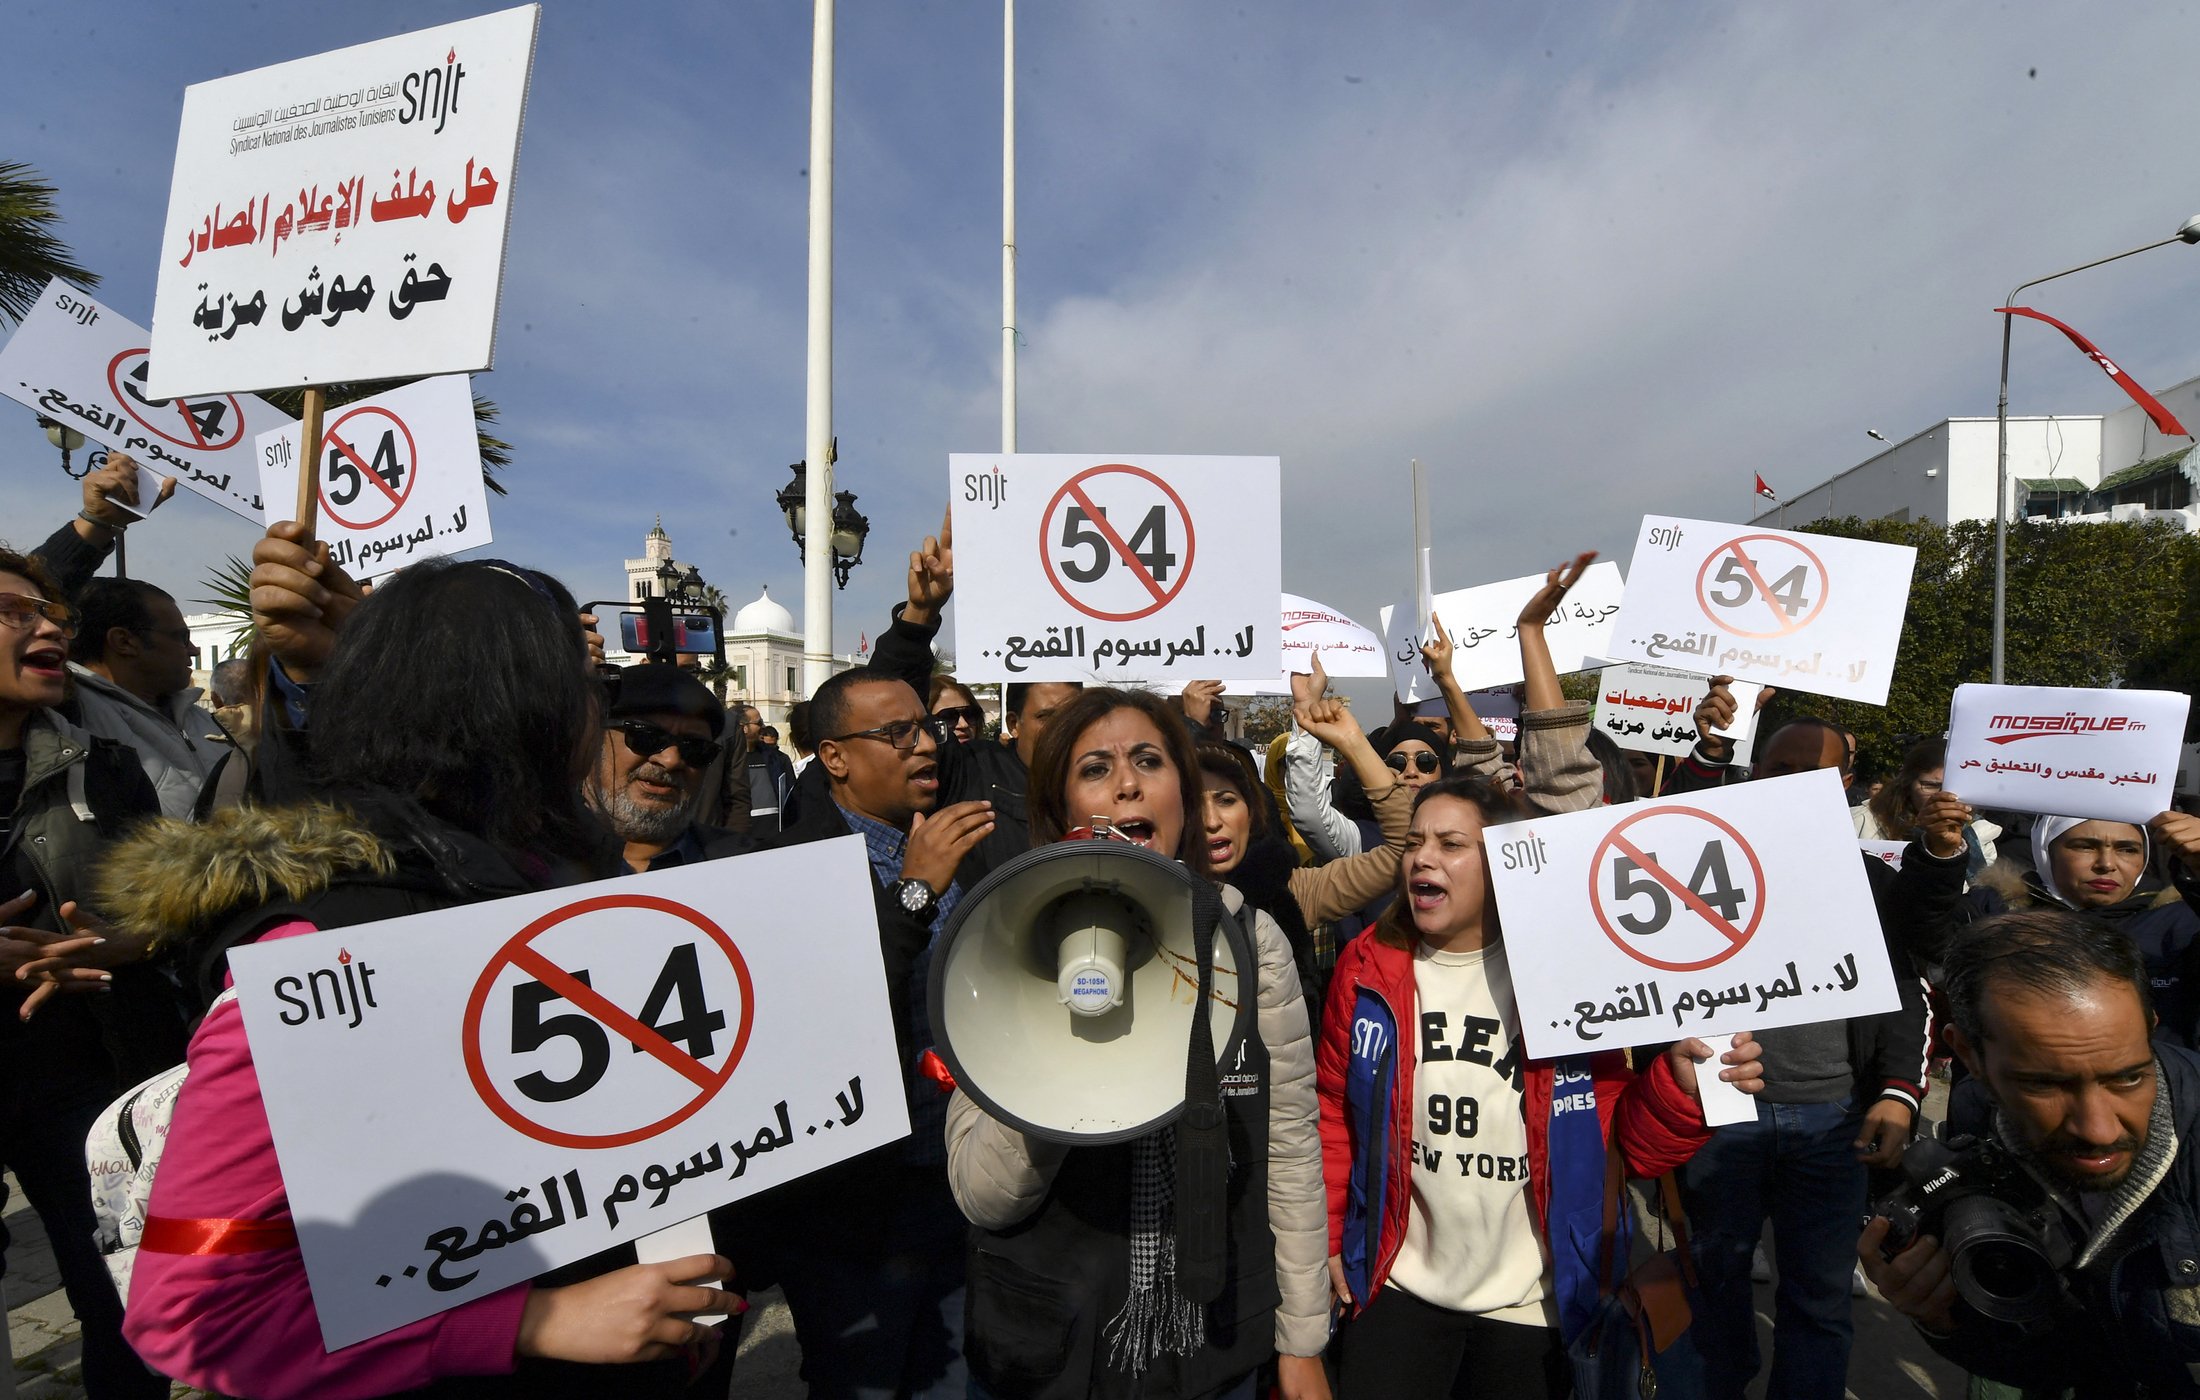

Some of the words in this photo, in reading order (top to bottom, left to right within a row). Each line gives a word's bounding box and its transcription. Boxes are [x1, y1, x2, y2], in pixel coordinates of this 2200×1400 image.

[323, 89, 364, 113] الوطنية
[367, 81, 400, 104] النقابة
[399, 46, 466, 135] snjt
[230, 132, 262, 157] Syndicat
[262, 127, 293, 149] National
[293, 123, 308, 140] des
[308, 113, 357, 138] Journalistes
[358, 107, 396, 128] Tunisiens
[370, 166, 436, 223] ملف
[447, 156, 499, 225] حل
[179, 191, 270, 268] المصادر
[272, 174, 365, 258] الإعلام
[281, 264, 375, 332] موش
[389, 252, 453, 321] حق
[55, 294, 101, 327] snjt
[192, 282, 268, 343] مزية
[19, 381, 127, 436] القمع..
[124, 436, 231, 491] لمرسوم
[265, 434, 292, 468] snjt
[328, 429, 405, 506] 54
[964, 464, 1008, 510] snjt
[438, 504, 468, 536] لا..
[1648, 523, 1684, 551] snjt
[328, 538, 354, 567] الق
[358, 514, 434, 570] لمرسوم
[1060, 505, 1176, 583] 54
[1710, 556, 1809, 617] 54
[1575, 602, 1620, 627] حرية
[982, 626, 1085, 673] القمع..
[1092, 625, 1205, 671] لمرسوم
[1213, 625, 1254, 659] لا..
[1463, 626, 1497, 648] حق
[1631, 631, 1717, 659] القمع..
[1718, 644, 1822, 678] لمرسوم
[1826, 660, 1867, 683] لا..
[1605, 689, 1692, 715] الوضعيات
[1989, 712, 2128, 734] mosaïque
[2127, 720, 2146, 731] fm
[1495, 725, 1518, 735] ROUG
[1607, 713, 1645, 736] مزية
[1652, 720, 1697, 743] موش
[1959, 758, 1981, 769] حر
[1986, 758, 2052, 779] والتعليق
[2057, 767, 2105, 781] مقدس
[2109, 771, 2157, 787] الخبر
[1501, 829, 1547, 875] snjt
[1613, 839, 1747, 936] 54
[273, 946, 377, 1030] snjt
[1073, 988, 1108, 996] MEGAPHONE
[1077, 977, 1105, 985] SD-10SH
[1811, 953, 1859, 992] لا..
[1549, 980, 1663, 1041] القمع..
[1671, 960, 1803, 1028] لمرسوم
[510, 942, 727, 1103] 54
[806, 1075, 866, 1137] لا..
[1428, 1094, 1479, 1138] 98
[1553, 1091, 1597, 1117] PRES
[603, 1099, 795, 1230] لمرسوم
[1411, 1141, 1443, 1174] EW
[1456, 1152, 1530, 1182] YORK
[1922, 1170, 1953, 1194] Nikon
[375, 1168, 588, 1292] القمع..
